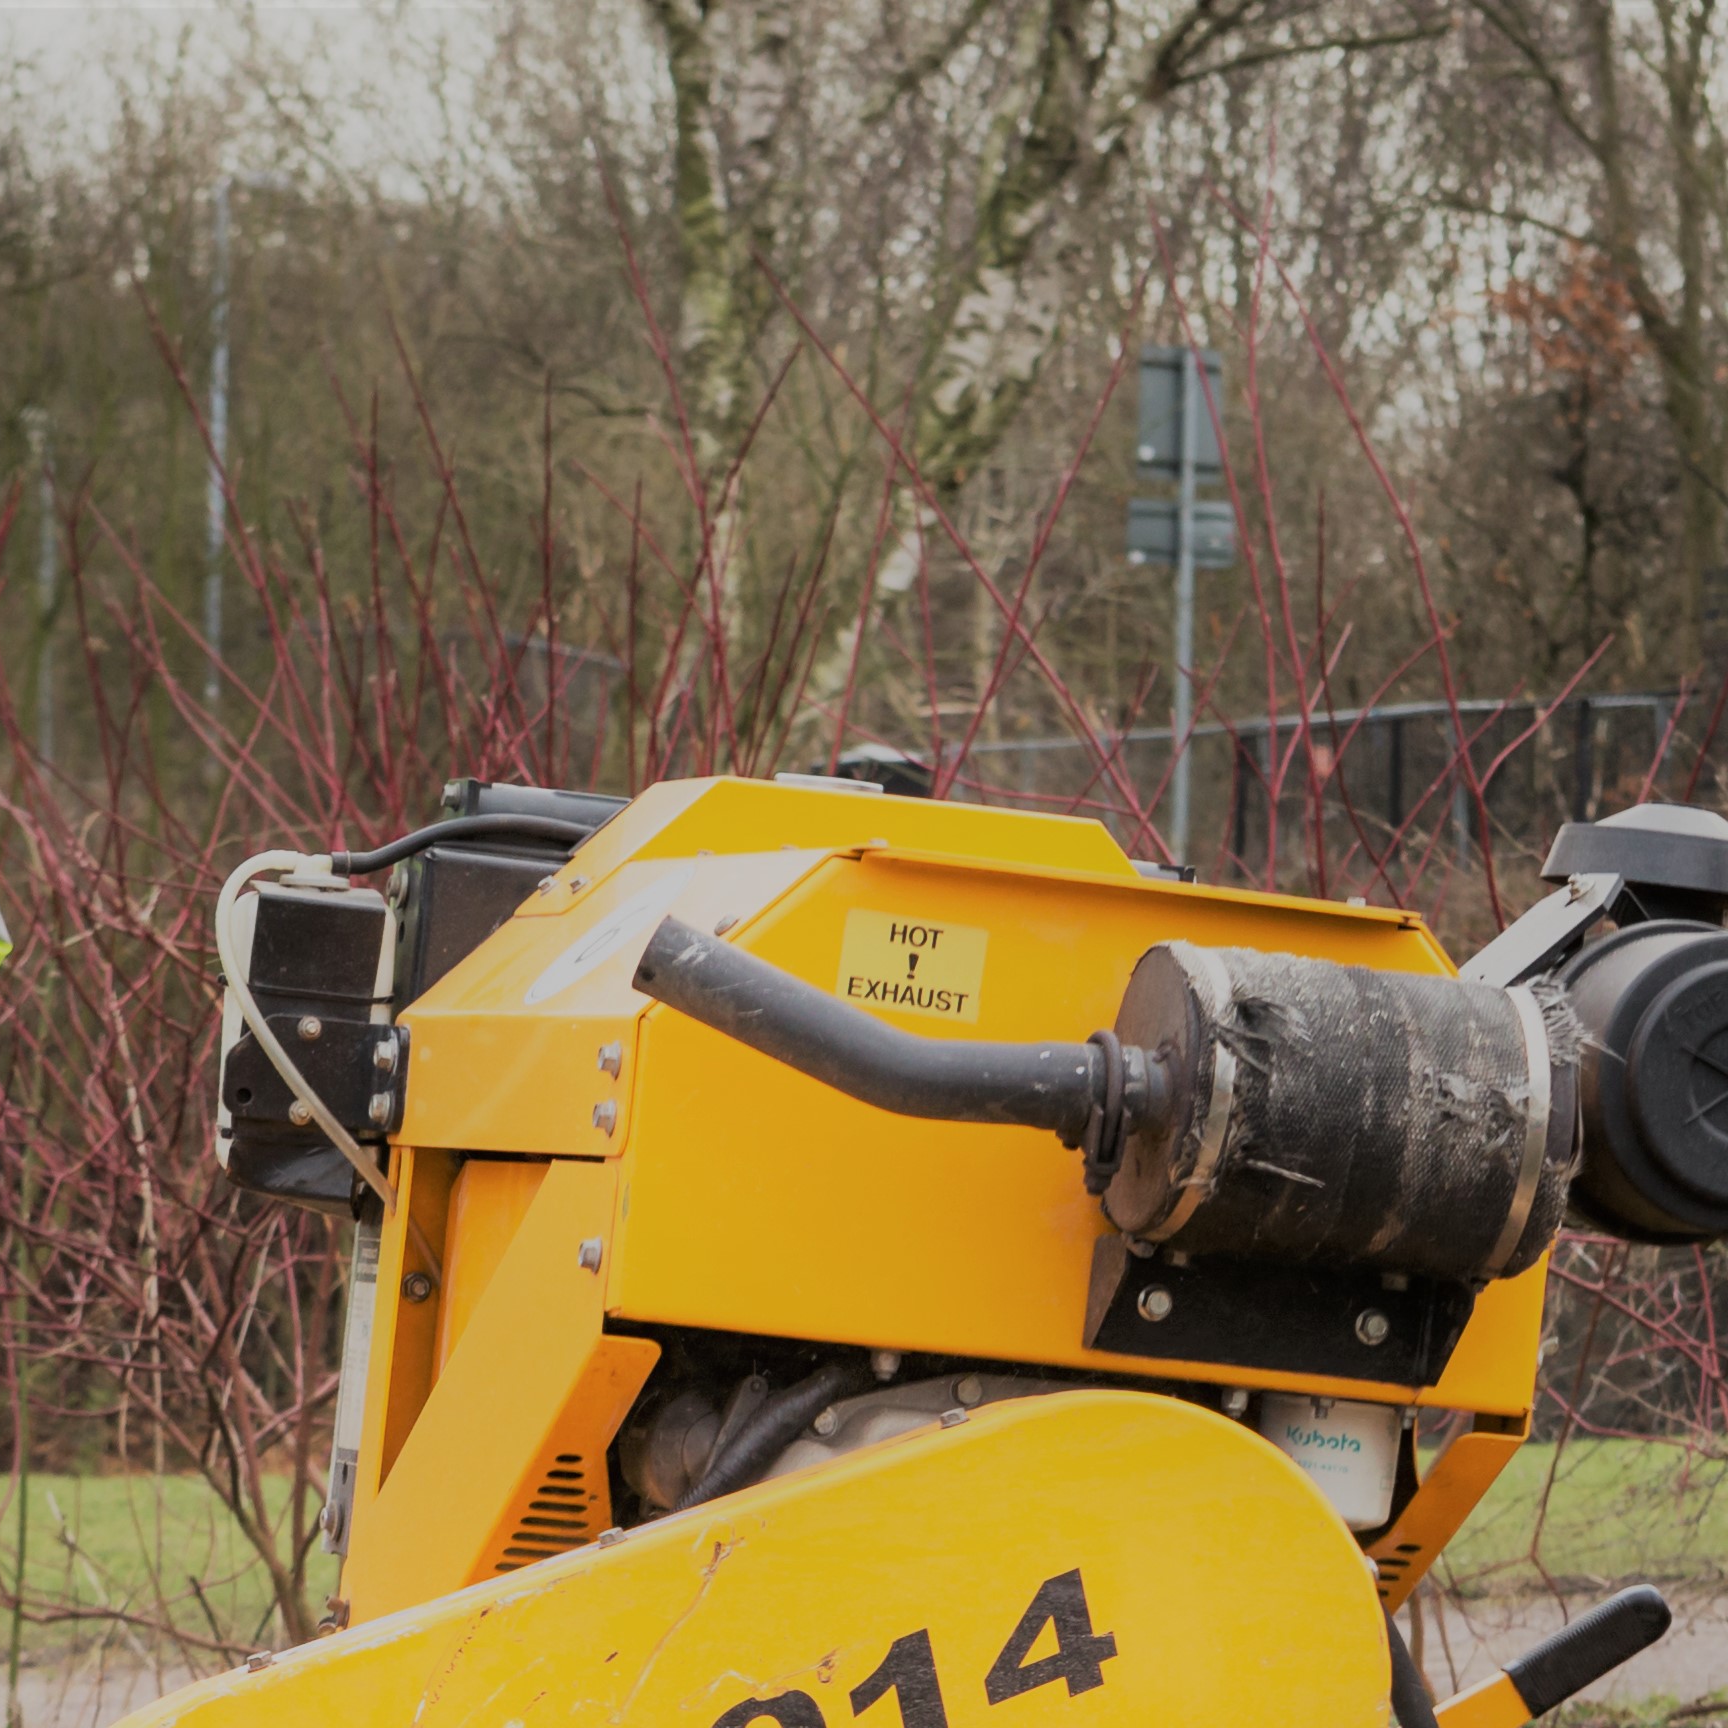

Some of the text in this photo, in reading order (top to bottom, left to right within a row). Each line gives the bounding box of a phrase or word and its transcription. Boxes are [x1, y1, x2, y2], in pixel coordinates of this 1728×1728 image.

[890, 922, 944, 950] HOT
[847, 976, 969, 1014] EXHAUST
[1286, 1425, 1361, 1452] Kubota
